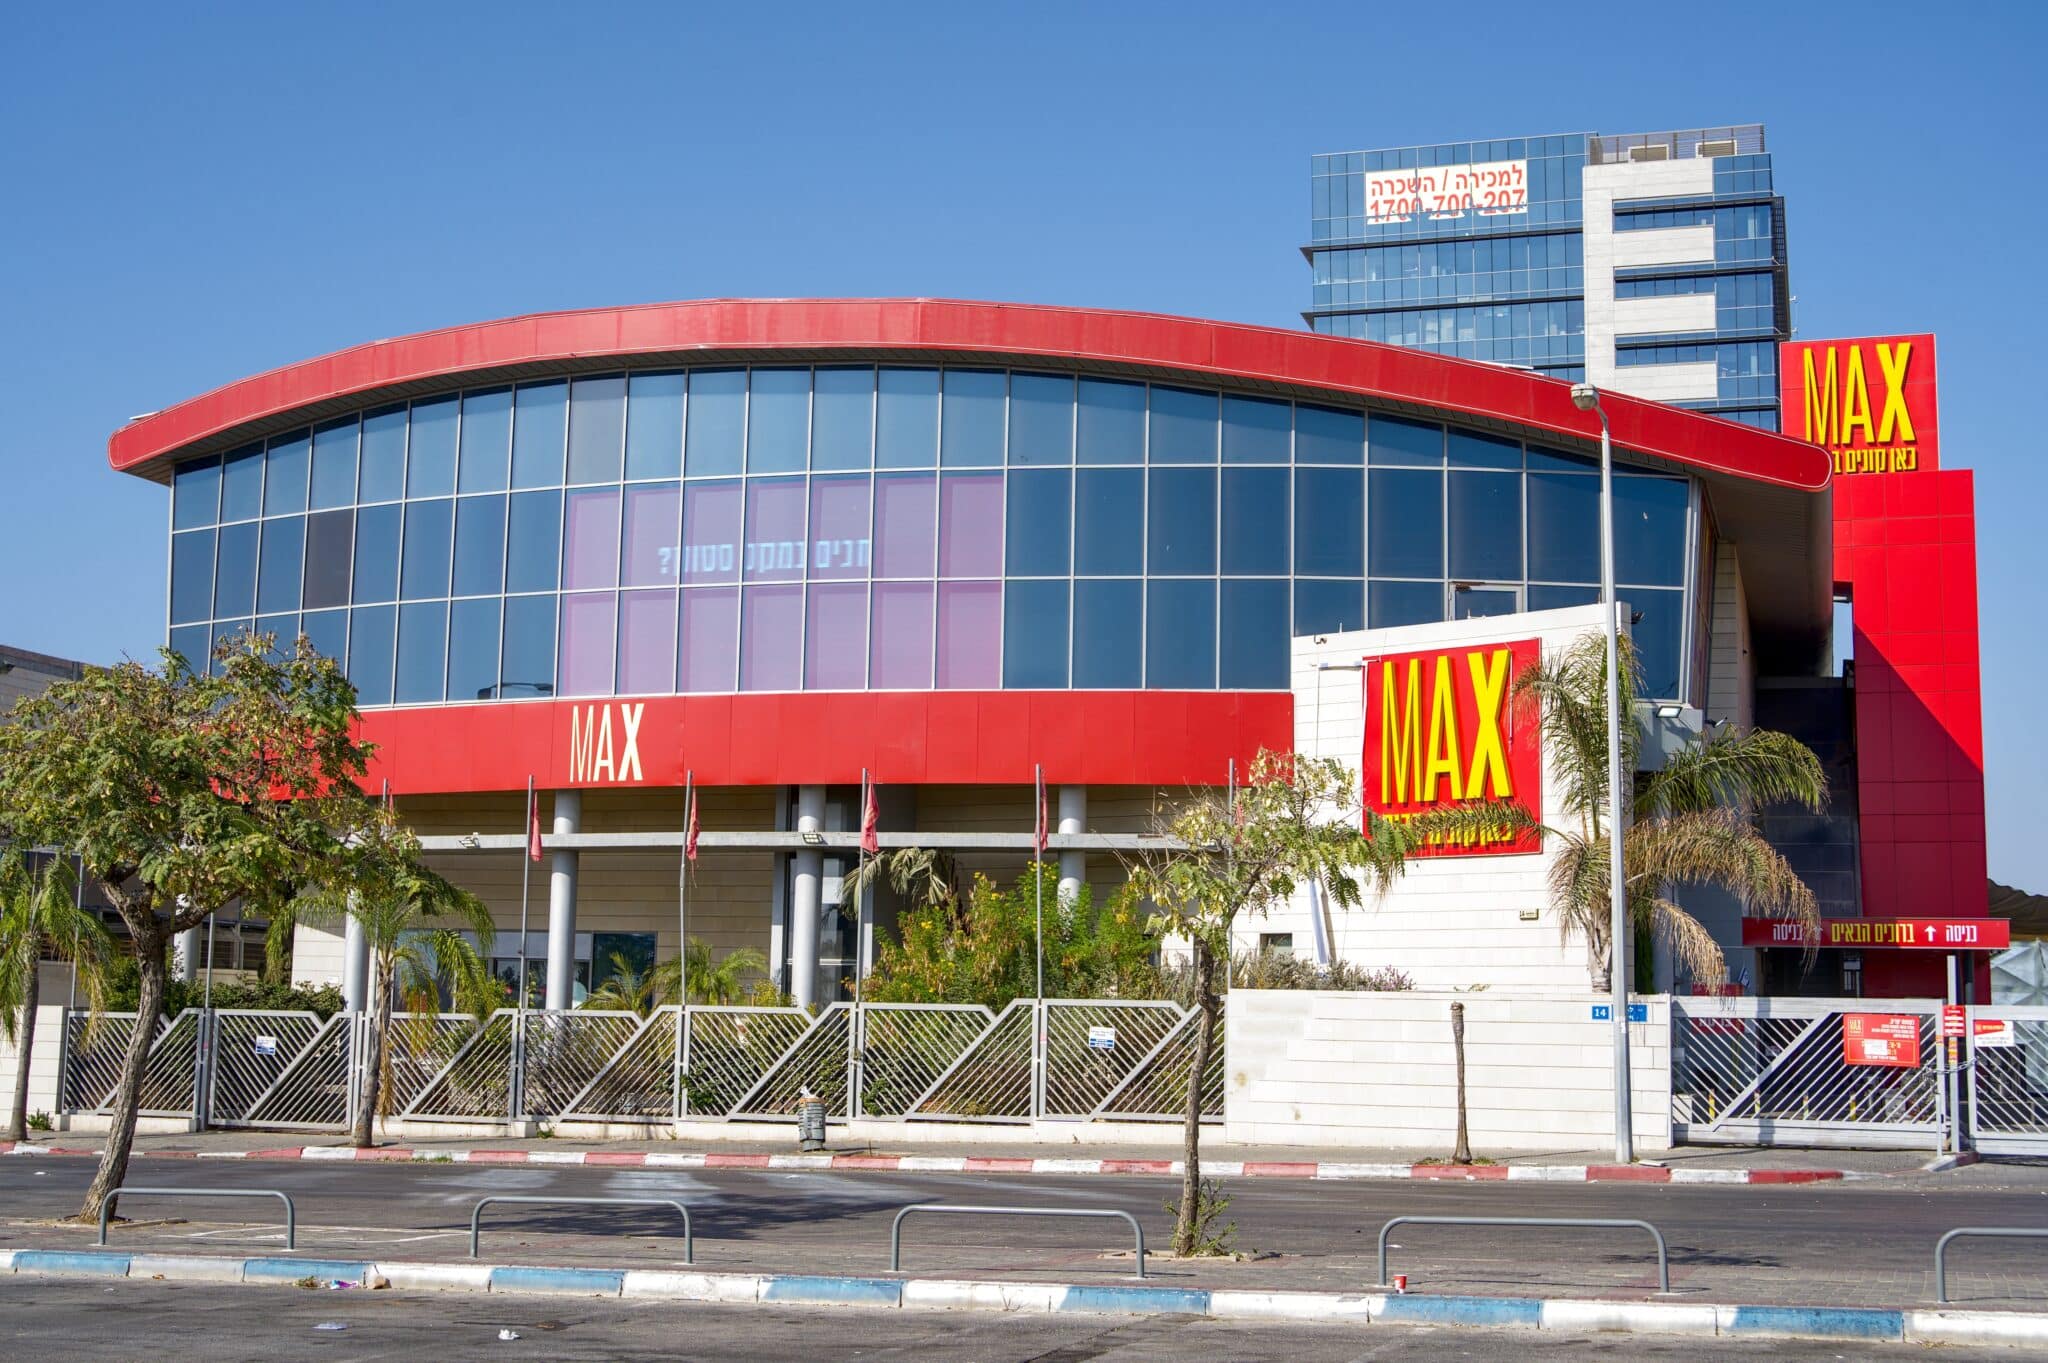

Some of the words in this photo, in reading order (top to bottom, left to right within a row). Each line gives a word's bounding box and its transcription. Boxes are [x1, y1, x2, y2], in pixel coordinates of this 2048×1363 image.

[1371, 176, 1436, 197] השכרה
[1456, 164, 1522, 190] למכירה
[1370, 189, 1525, 222] 1700-700-207
[1803, 342, 1916, 445] MAX
[1844, 448, 1887, 474] קונים
[1890, 447, 1917, 473] כאן
[1381, 649, 1513, 804] MAX
[569, 703, 645, 783] MAX
[1773, 924, 1803, 941] כניסה
[1831, 923, 1871, 943] הבאים
[1874, 923, 1915, 943] ברוכים
[1946, 924, 1977, 942] כניסה
[1594, 1008, 1607, 1017] 14
